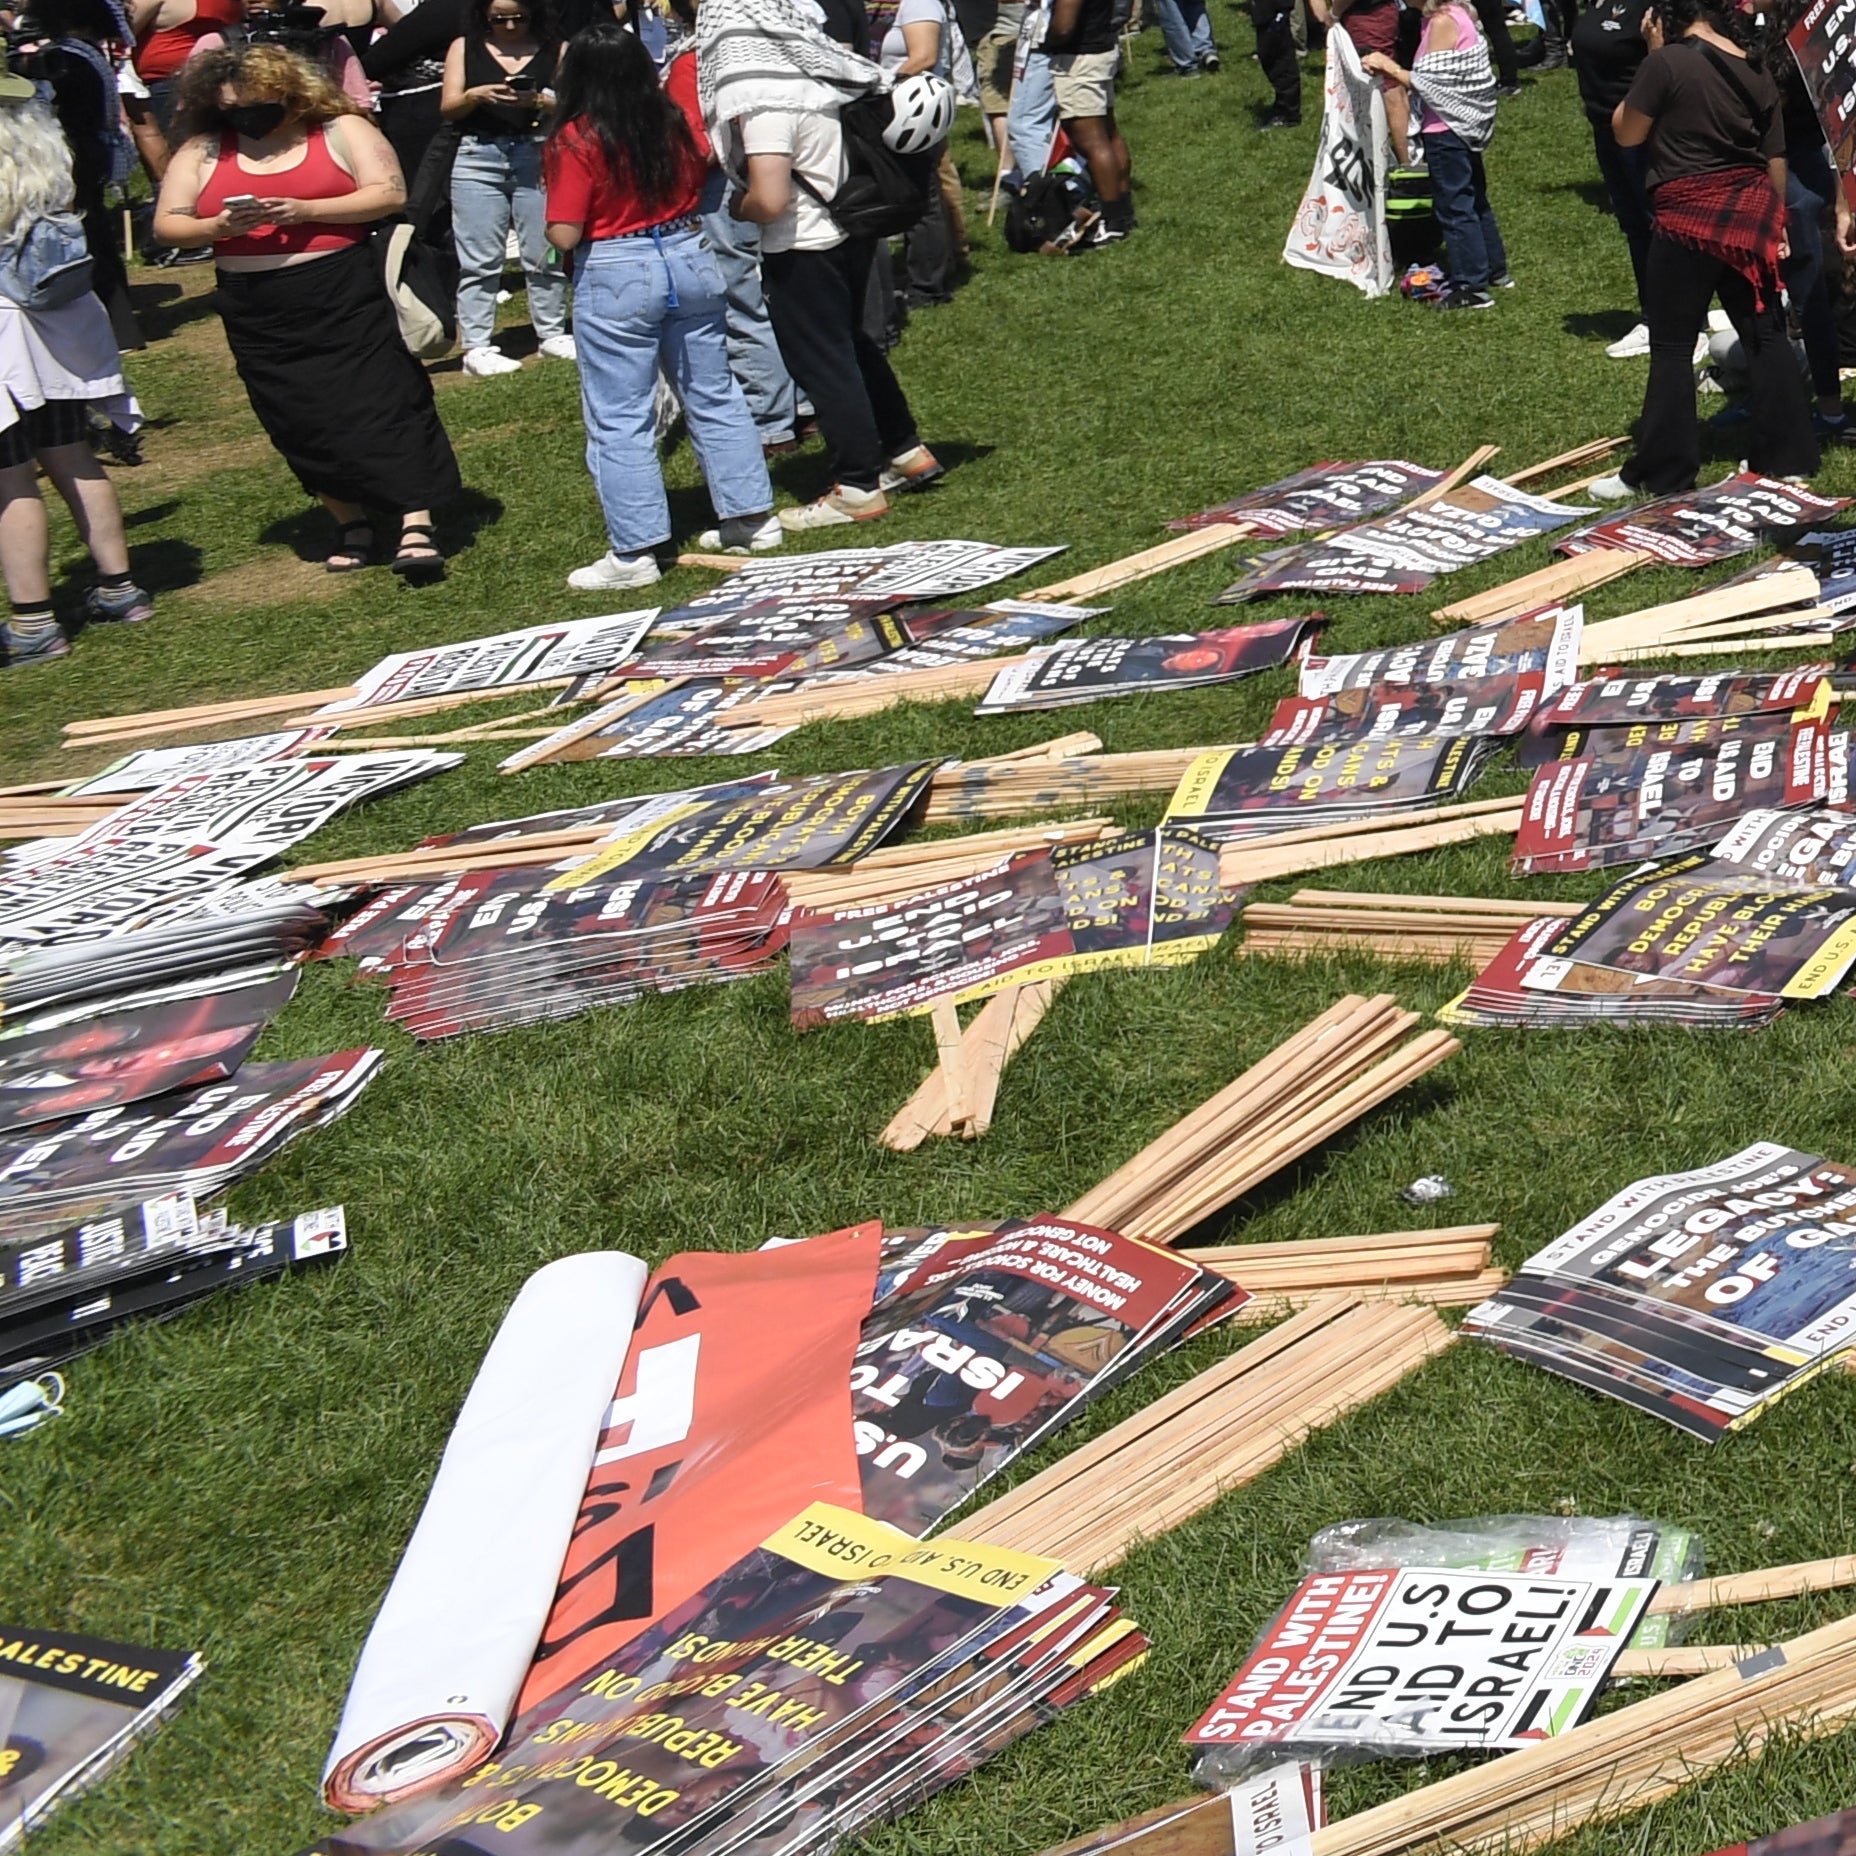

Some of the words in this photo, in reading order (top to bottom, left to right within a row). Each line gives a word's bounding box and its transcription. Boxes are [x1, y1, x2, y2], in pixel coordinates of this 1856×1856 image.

[1822, 35, 1851, 74] U.S.
[1545, 1213, 1617, 1261] STAND
[1590, 1184, 1729, 1266] GENOCIDE
[1617, 1171, 1847, 1280] LEGACY:
[1662, 1243, 1741, 1291] THE
[1703, 1255, 1782, 1305] OF
[1376, 1583, 1450, 1648] U.S
[1435, 1584, 1513, 1645] TO
[1199, 1659, 1280, 1739] STAND
[1271, 1576, 1347, 1650] WITH
[1240, 1573, 1390, 1736] PALESTINE!
[1441, 1585, 1578, 1736] ISRAEL!
